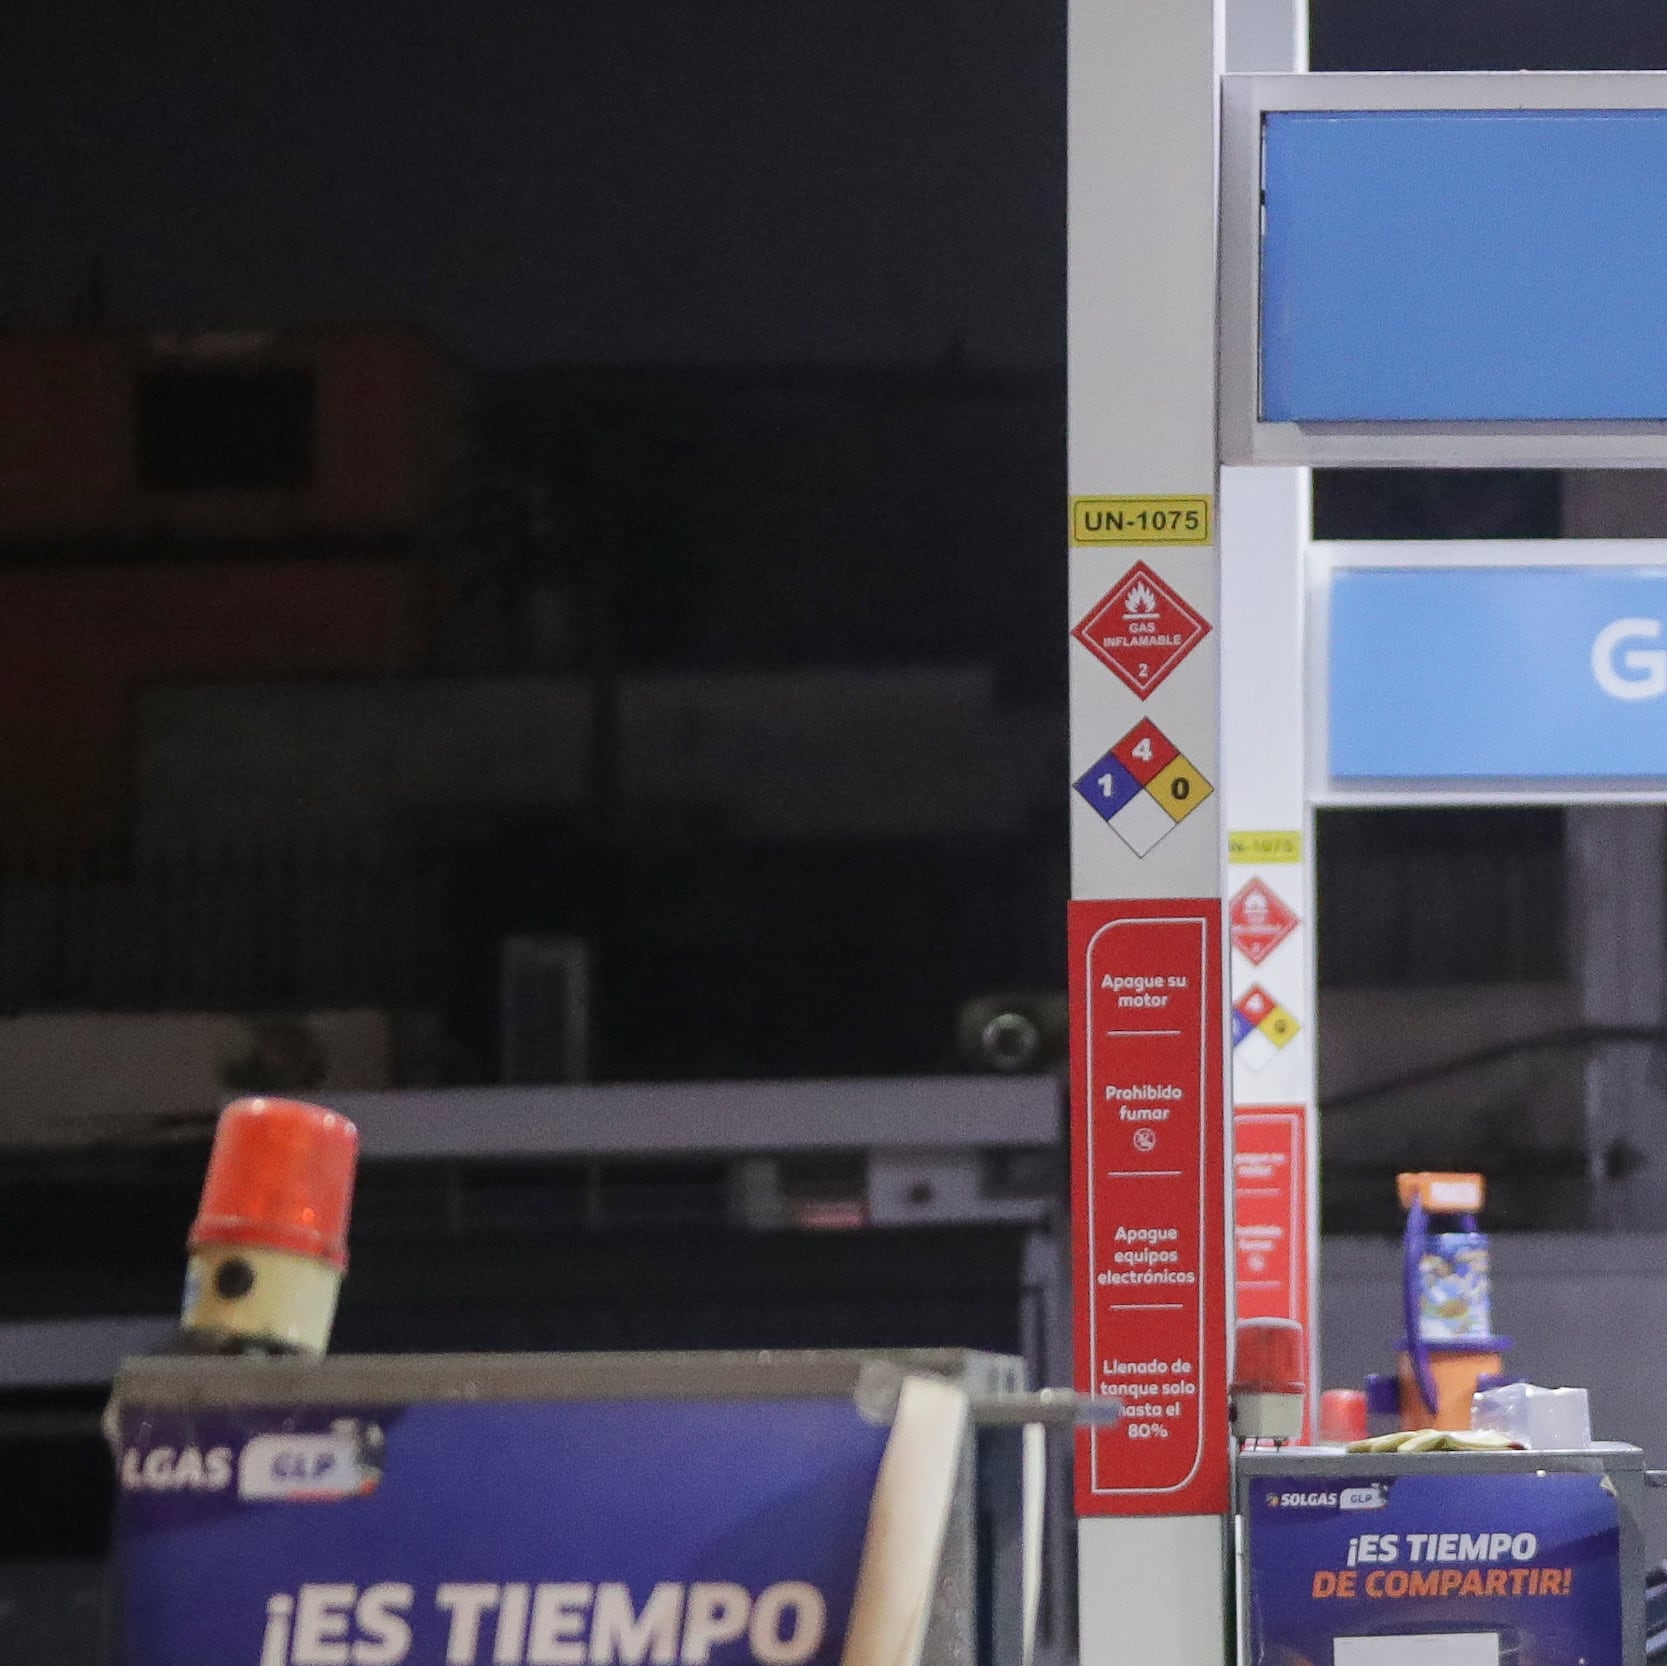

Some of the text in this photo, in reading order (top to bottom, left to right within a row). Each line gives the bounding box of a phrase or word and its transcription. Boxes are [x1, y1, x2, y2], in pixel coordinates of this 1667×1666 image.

[1085, 511, 1199, 531] UN-1075
[1129, 623, 1155, 633] GAS
[1103, 635, 1181, 647] INFLAMABLE
[1139, 664, 1148, 677] 2
[1132, 738, 1152, 760] 4
[1098, 774, 1189, 801] 1 0
[1101, 974, 1188, 991] Apague su
[1117, 992, 1168, 1007] motor
[1105, 1084, 1182, 1101] Prohibido
[1119, 1103, 1169, 1121] fumar
[1114, 1227, 1178, 1245] Apague
[1114, 1247, 1178, 1266] equipos
[1098, 1267, 1195, 1285] electrónicos
[1103, 1358, 1192, 1374] Llenado de
[1101, 1380, 1196, 1399] tanque solo
[1166, 1401, 1180, 1416] el
[1128, 1423, 1168, 1438] 80%
[121, 1446, 335, 1491] LGAS GLP
[1280, 1493, 1372, 1506] SOLGAS GLP
[1346, 1532, 1538, 1567] ¡ES TIEMPO
[1311, 1568, 1574, 1599] DE COMPARTIR!
